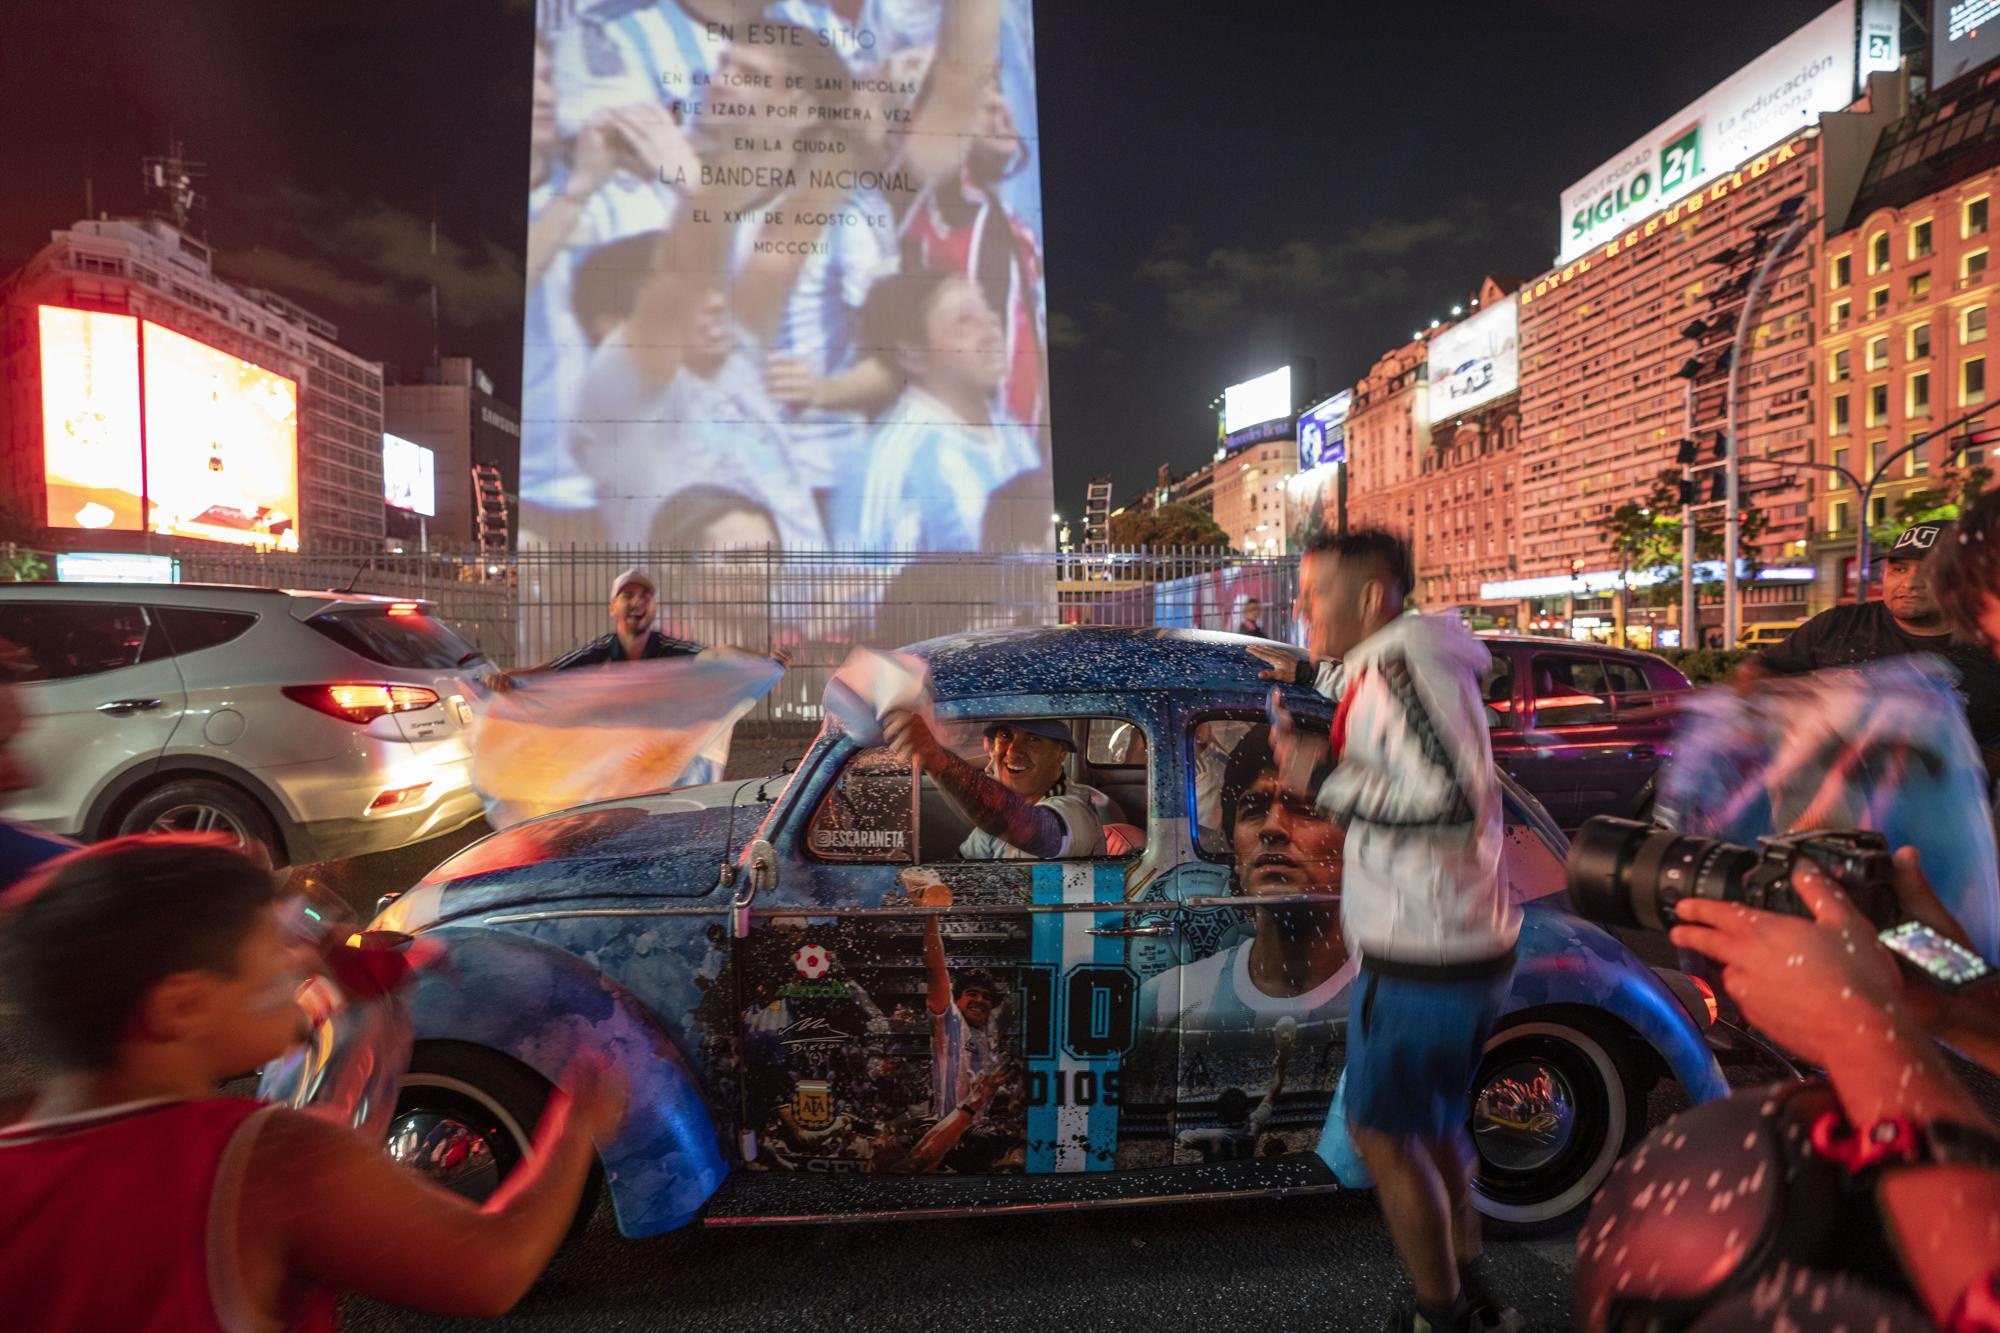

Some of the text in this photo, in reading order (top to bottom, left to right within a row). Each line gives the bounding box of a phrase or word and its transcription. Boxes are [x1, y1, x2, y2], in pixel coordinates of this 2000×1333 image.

[706, 22, 876, 49] EN ESTE SITIO
[1870, 36, 1891, 60] 21
[662, 72, 917, 95] EN LA TORRE DE SAN NICOLAS
[1717, 54, 1834, 136] La educación
[673, 101, 912, 123] FUE IZADA POR PRIMERA VEZ
[734, 137, 846, 154] EN LA CIUDAD
[659, 164, 918, 193] LA BANDERA NACIONAL
[1571, 146, 1697, 241] SIGLO 21
[693, 209, 712, 224] EL
[764, 211, 783, 225] DE
[794, 212, 858, 227] AGOSTO
[867, 214, 886, 229] DE
[753, 241, 829, 256] MDCCCXII
[1521, 259, 1591, 305] HOTEL
[1016, 962, 1140, 1061] 10
